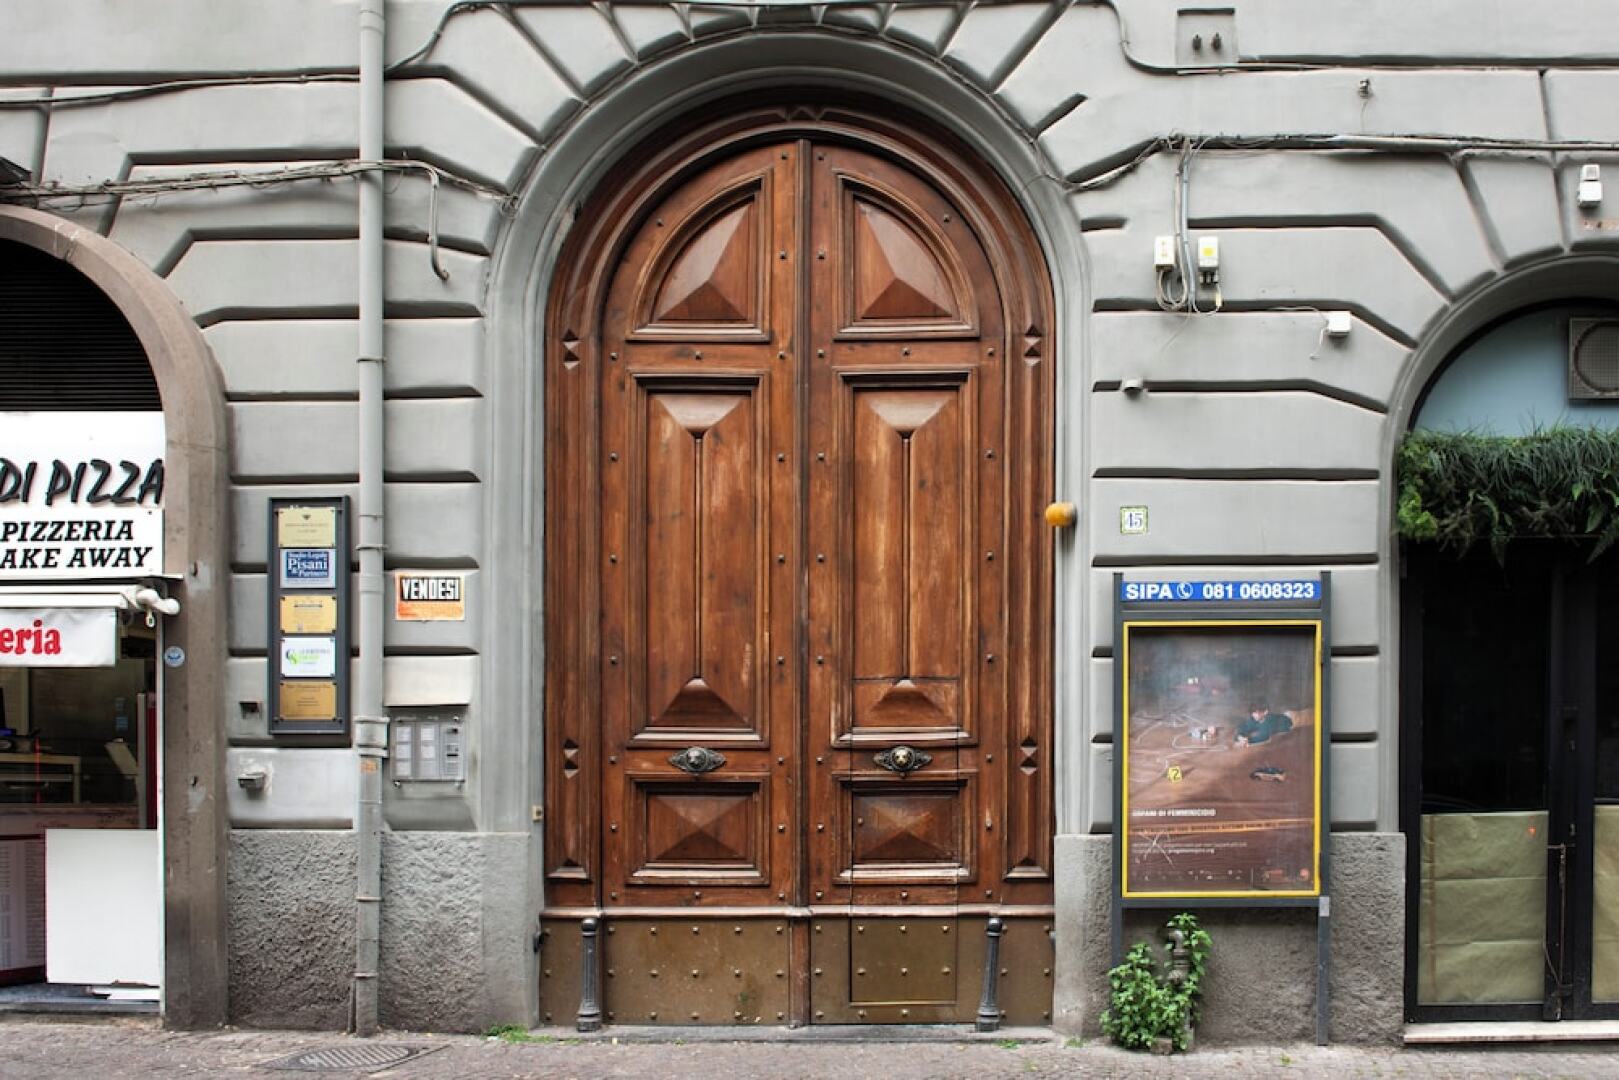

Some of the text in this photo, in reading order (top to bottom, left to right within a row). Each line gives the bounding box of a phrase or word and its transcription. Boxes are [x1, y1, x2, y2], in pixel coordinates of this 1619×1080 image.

[45, 458, 165, 506] PIZZA
[0, 520, 134, 542] PIZZERIA
[66, 547, 153, 568] AWAY
[287, 557, 328, 571] Pisani
[401, 578, 460, 600] VENDESI
[1126, 582, 1314, 600] SIPA 081 0608323
